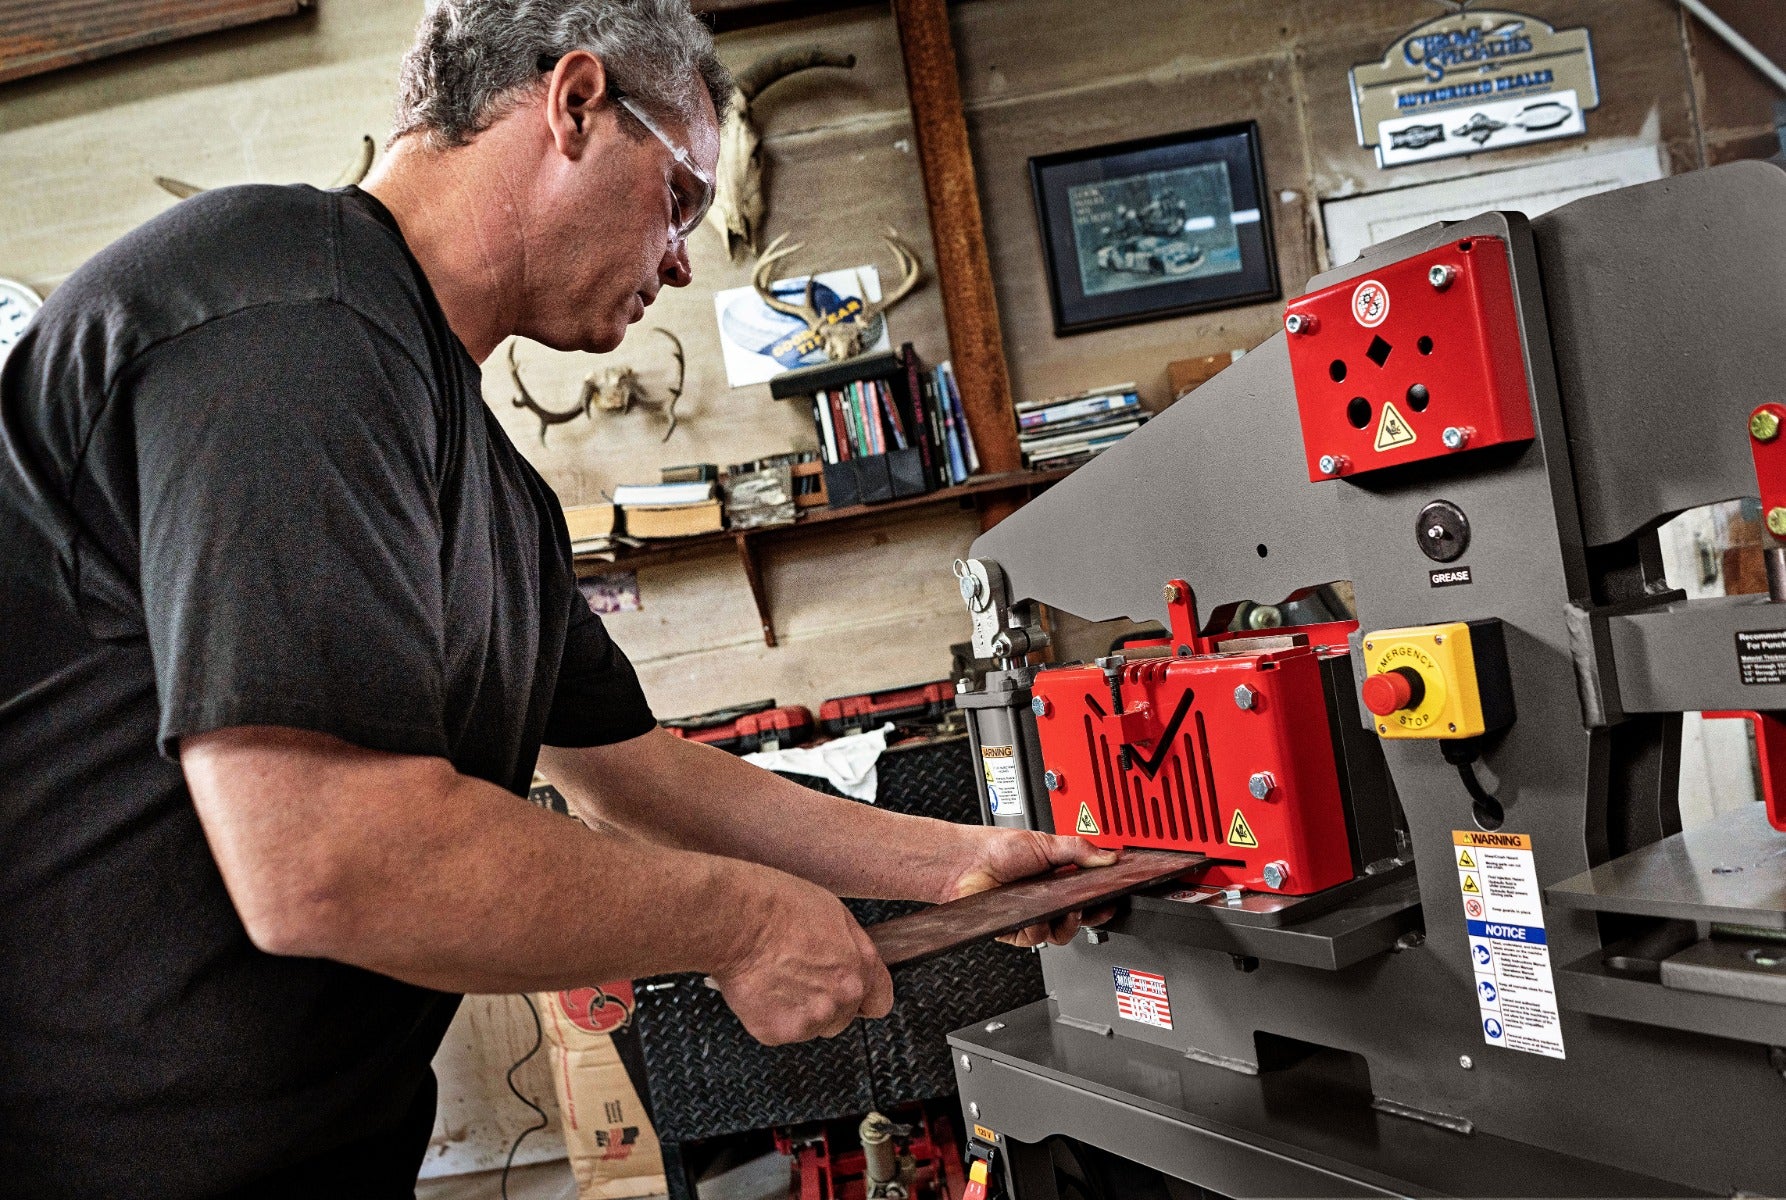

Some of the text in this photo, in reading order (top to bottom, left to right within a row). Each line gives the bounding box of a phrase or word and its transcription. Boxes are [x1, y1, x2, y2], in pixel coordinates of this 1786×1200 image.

[1432, 571, 1469, 583] GREASE
[1377, 647, 1434, 675] EMERGENCY
[1400, 714, 1429, 726] STOP
[1471, 833, 1521, 847] WARNING
[1485, 924, 1526, 939] NOTICE
[1129, 996, 1161, 1025] USA
